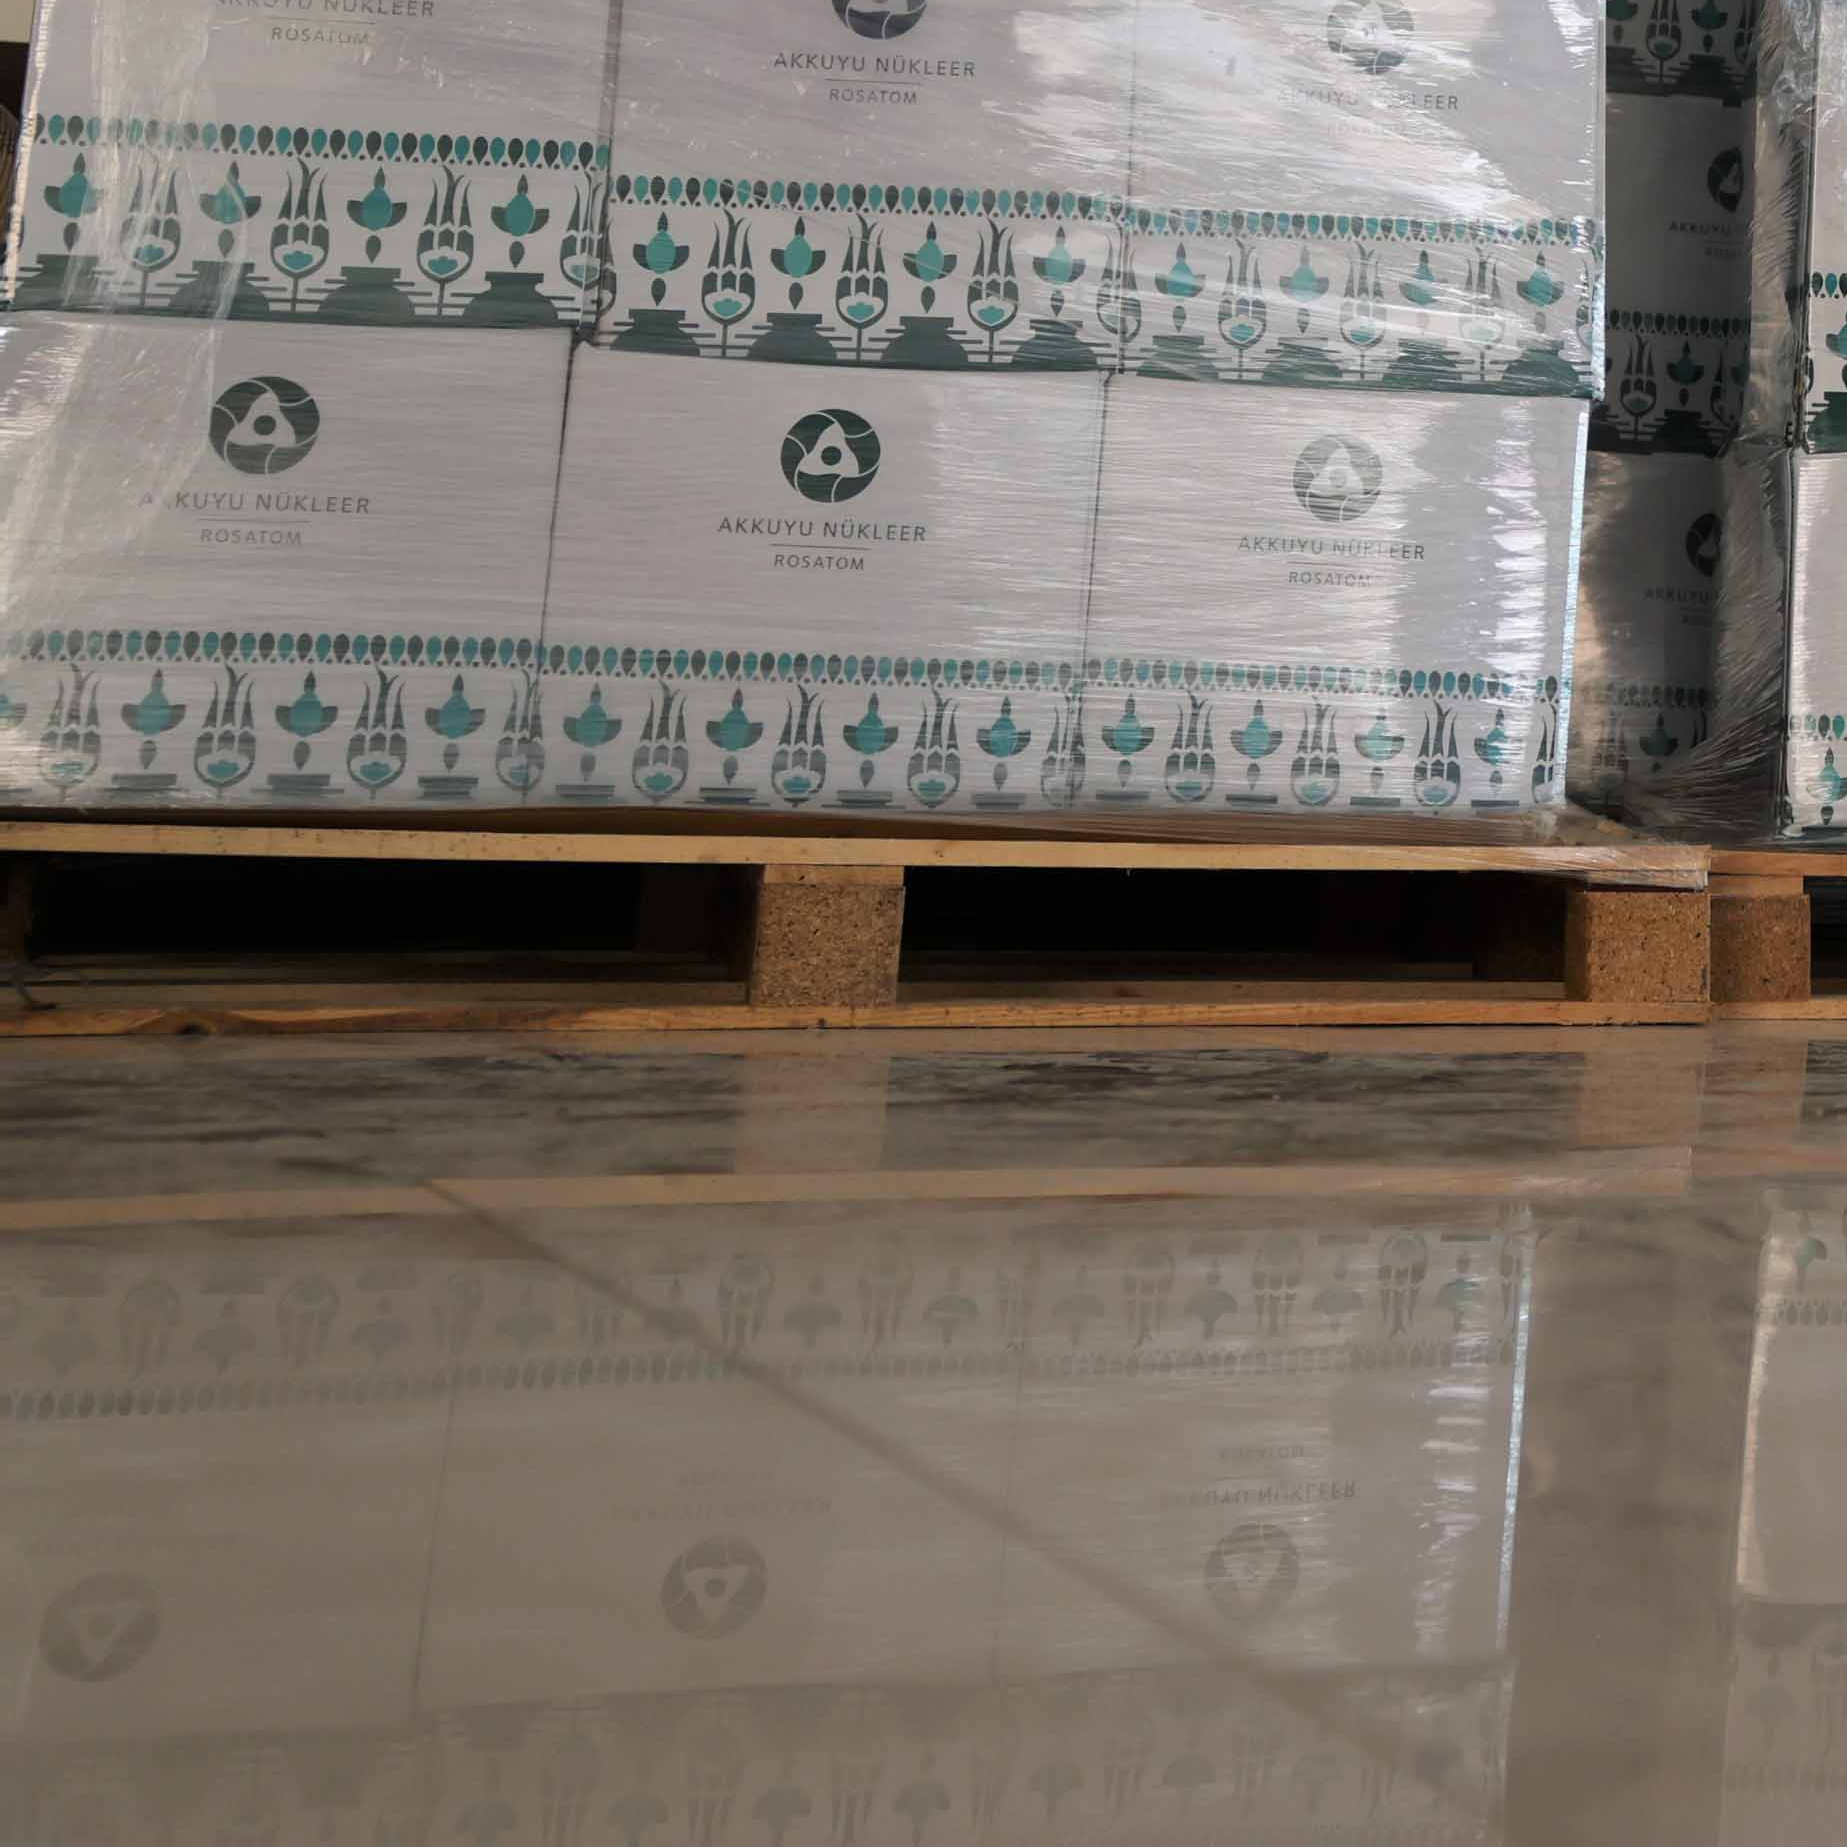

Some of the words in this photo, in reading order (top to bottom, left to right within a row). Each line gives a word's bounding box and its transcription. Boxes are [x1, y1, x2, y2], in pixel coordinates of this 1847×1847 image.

[773, 51, 865, 73] AKKUYU
[875, 54, 975, 78] NÜKLEER
[828, 88, 918, 105] ROSATOM
[138, 491, 245, 511] AKUYU
[255, 491, 370, 514] NÜKLEER
[200, 527, 303, 546] ROSATOM
[717, 517, 814, 538] AKKUYU
[822, 518, 926, 542] NÜKLEER
[1239, 536, 1325, 555] AKKUYU
[773, 554, 865, 571] ROSATOM
